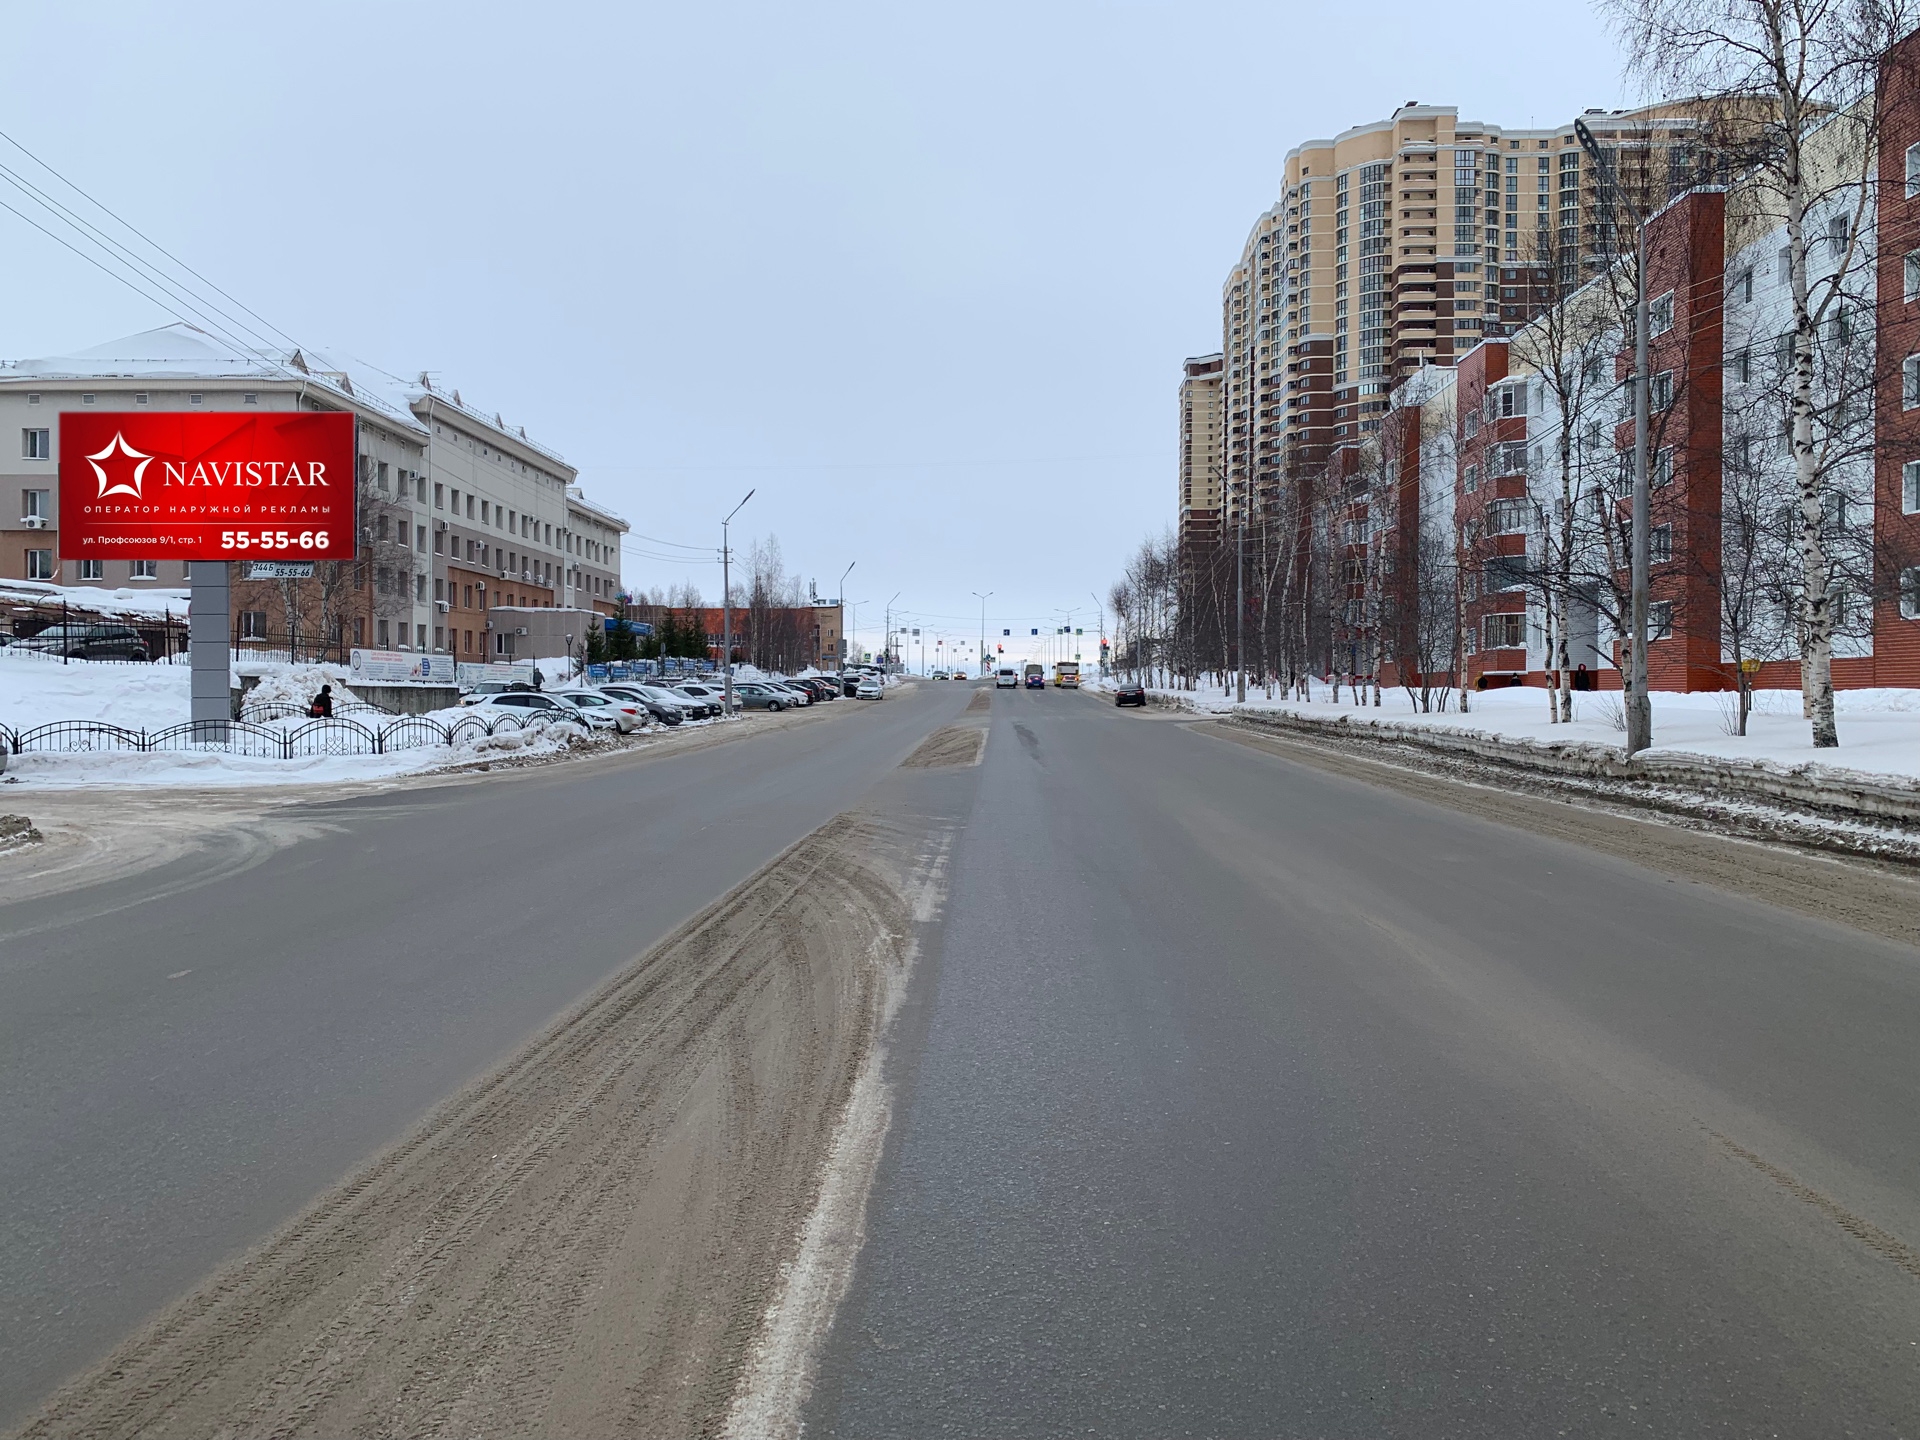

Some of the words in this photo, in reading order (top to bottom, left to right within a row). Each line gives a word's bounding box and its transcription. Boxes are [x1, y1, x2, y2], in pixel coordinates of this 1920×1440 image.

[162, 461, 330, 487] NAVISTAR
[84, 505, 160, 513] ОПЕРАТОР
[169, 504, 251, 513] НАРУЖНОЙ
[261, 505, 331, 513] РЕКЛАМЫ
[82, 537, 96, 546] ул.
[98, 536, 158, 546] Профсоюзов
[159, 536, 176, 546] 9/1,
[178, 538, 196, 546] стр.
[198, 536, 202, 544] 1
[220, 531, 330, 550] 55-55-66
[253, 563, 274, 571] 344Б
[274, 568, 310, 577] 55-55-66
